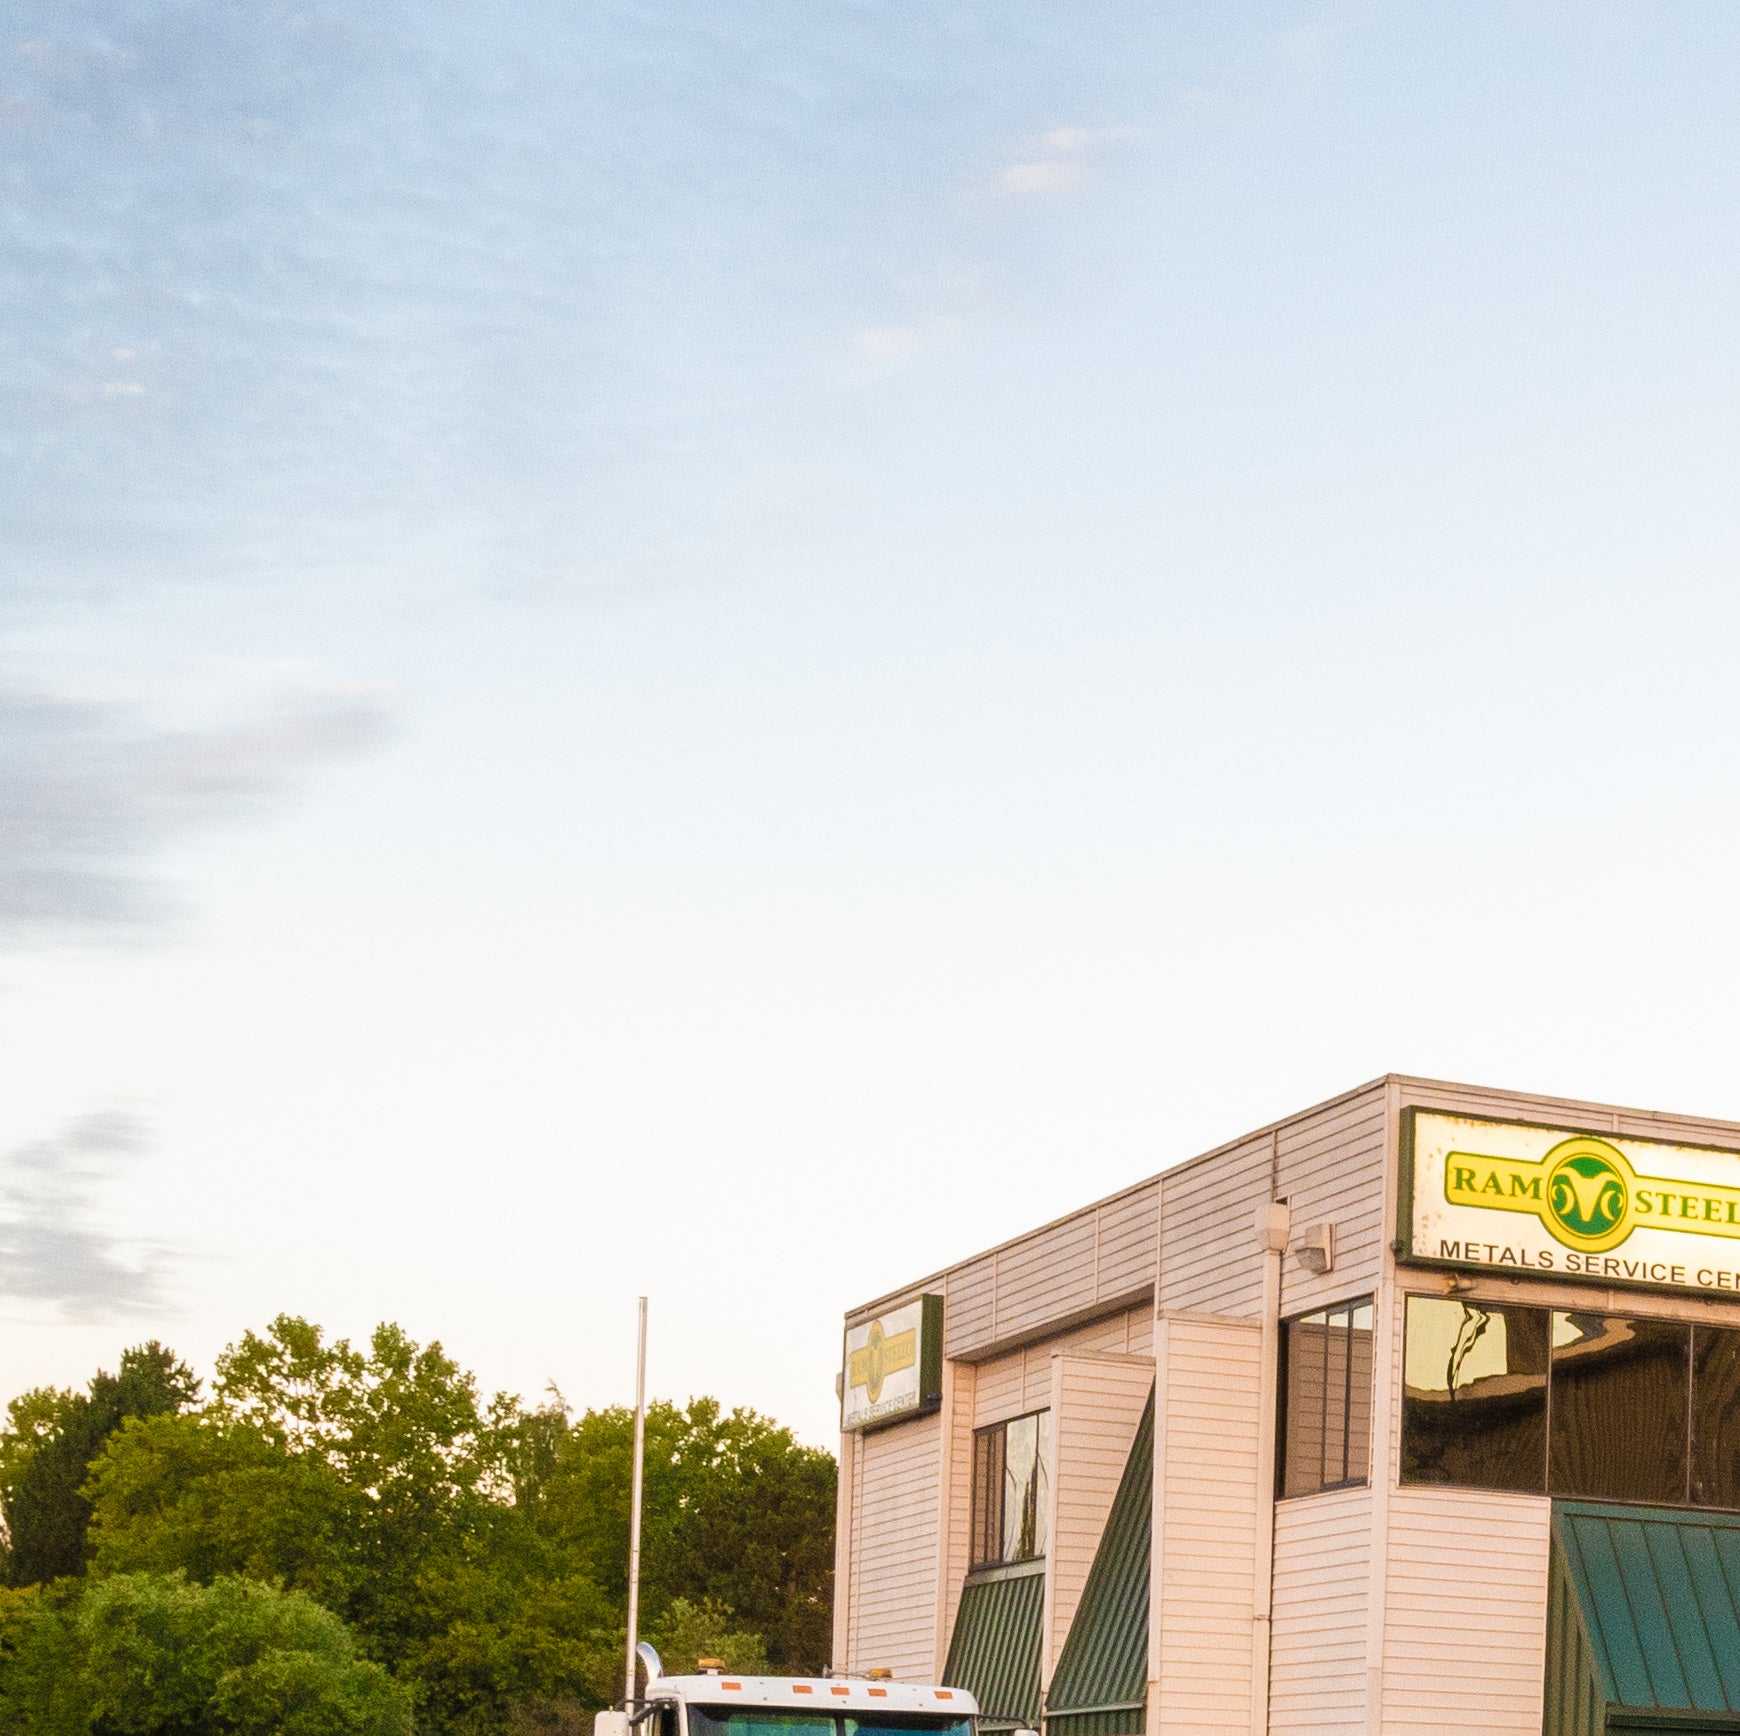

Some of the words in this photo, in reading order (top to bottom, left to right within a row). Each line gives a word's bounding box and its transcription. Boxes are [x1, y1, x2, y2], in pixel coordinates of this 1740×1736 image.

[1453, 1167, 1542, 1200] RAM
[1439, 1239, 1554, 1269] METALS
[1565, 1253, 1686, 1284] SERVICE
